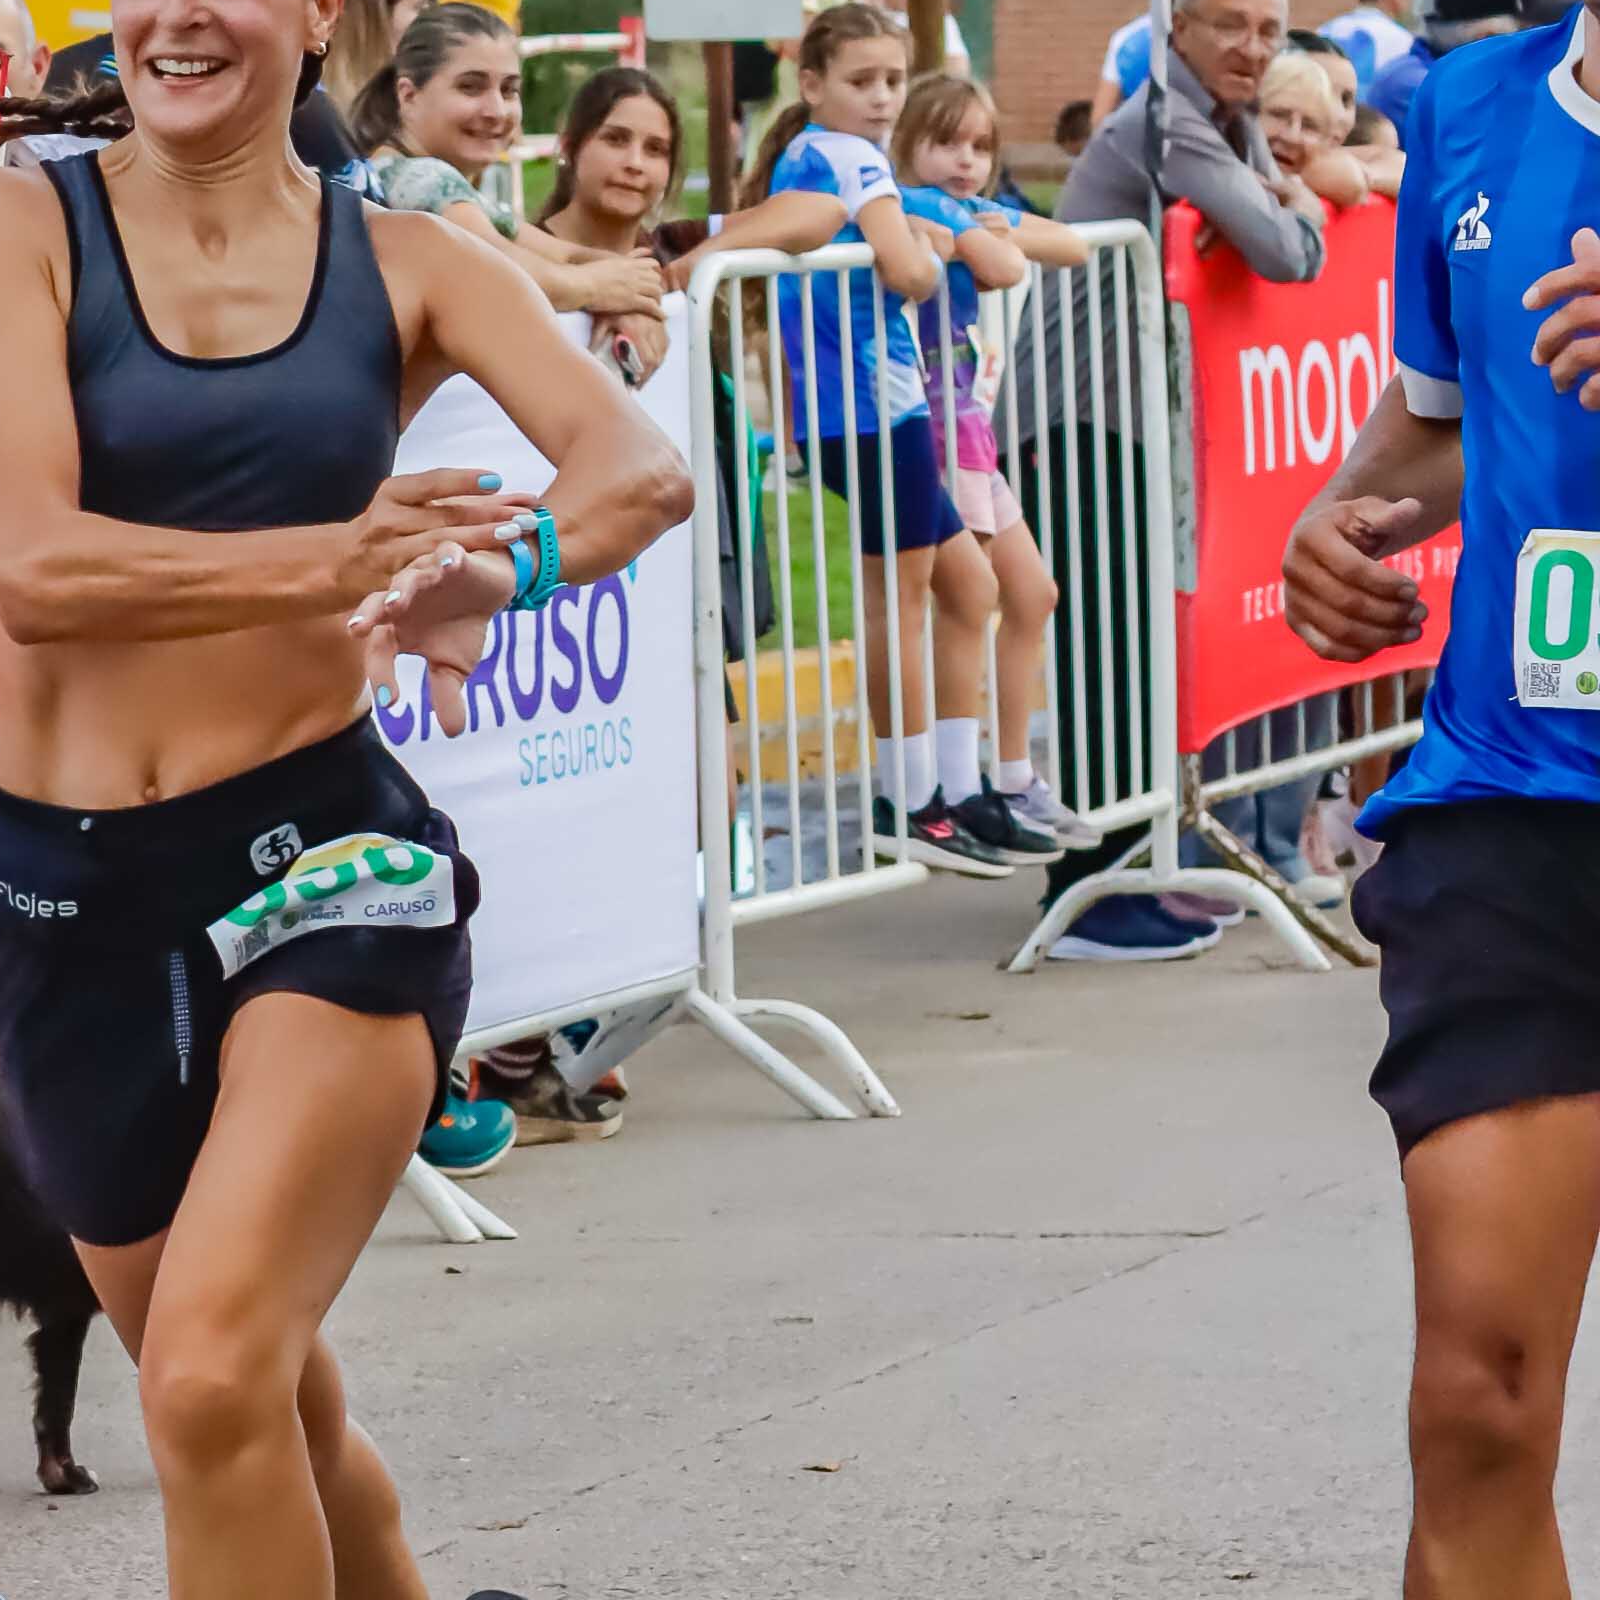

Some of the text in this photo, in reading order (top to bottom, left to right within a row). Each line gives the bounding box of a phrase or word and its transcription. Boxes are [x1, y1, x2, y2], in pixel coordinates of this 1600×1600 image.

[1239, 278, 1393, 475] mopl
[1528, 548, 1600, 661] 0
[518, 715, 634, 787] SEGUROS
[363, 898, 436, 918] CARUSO
